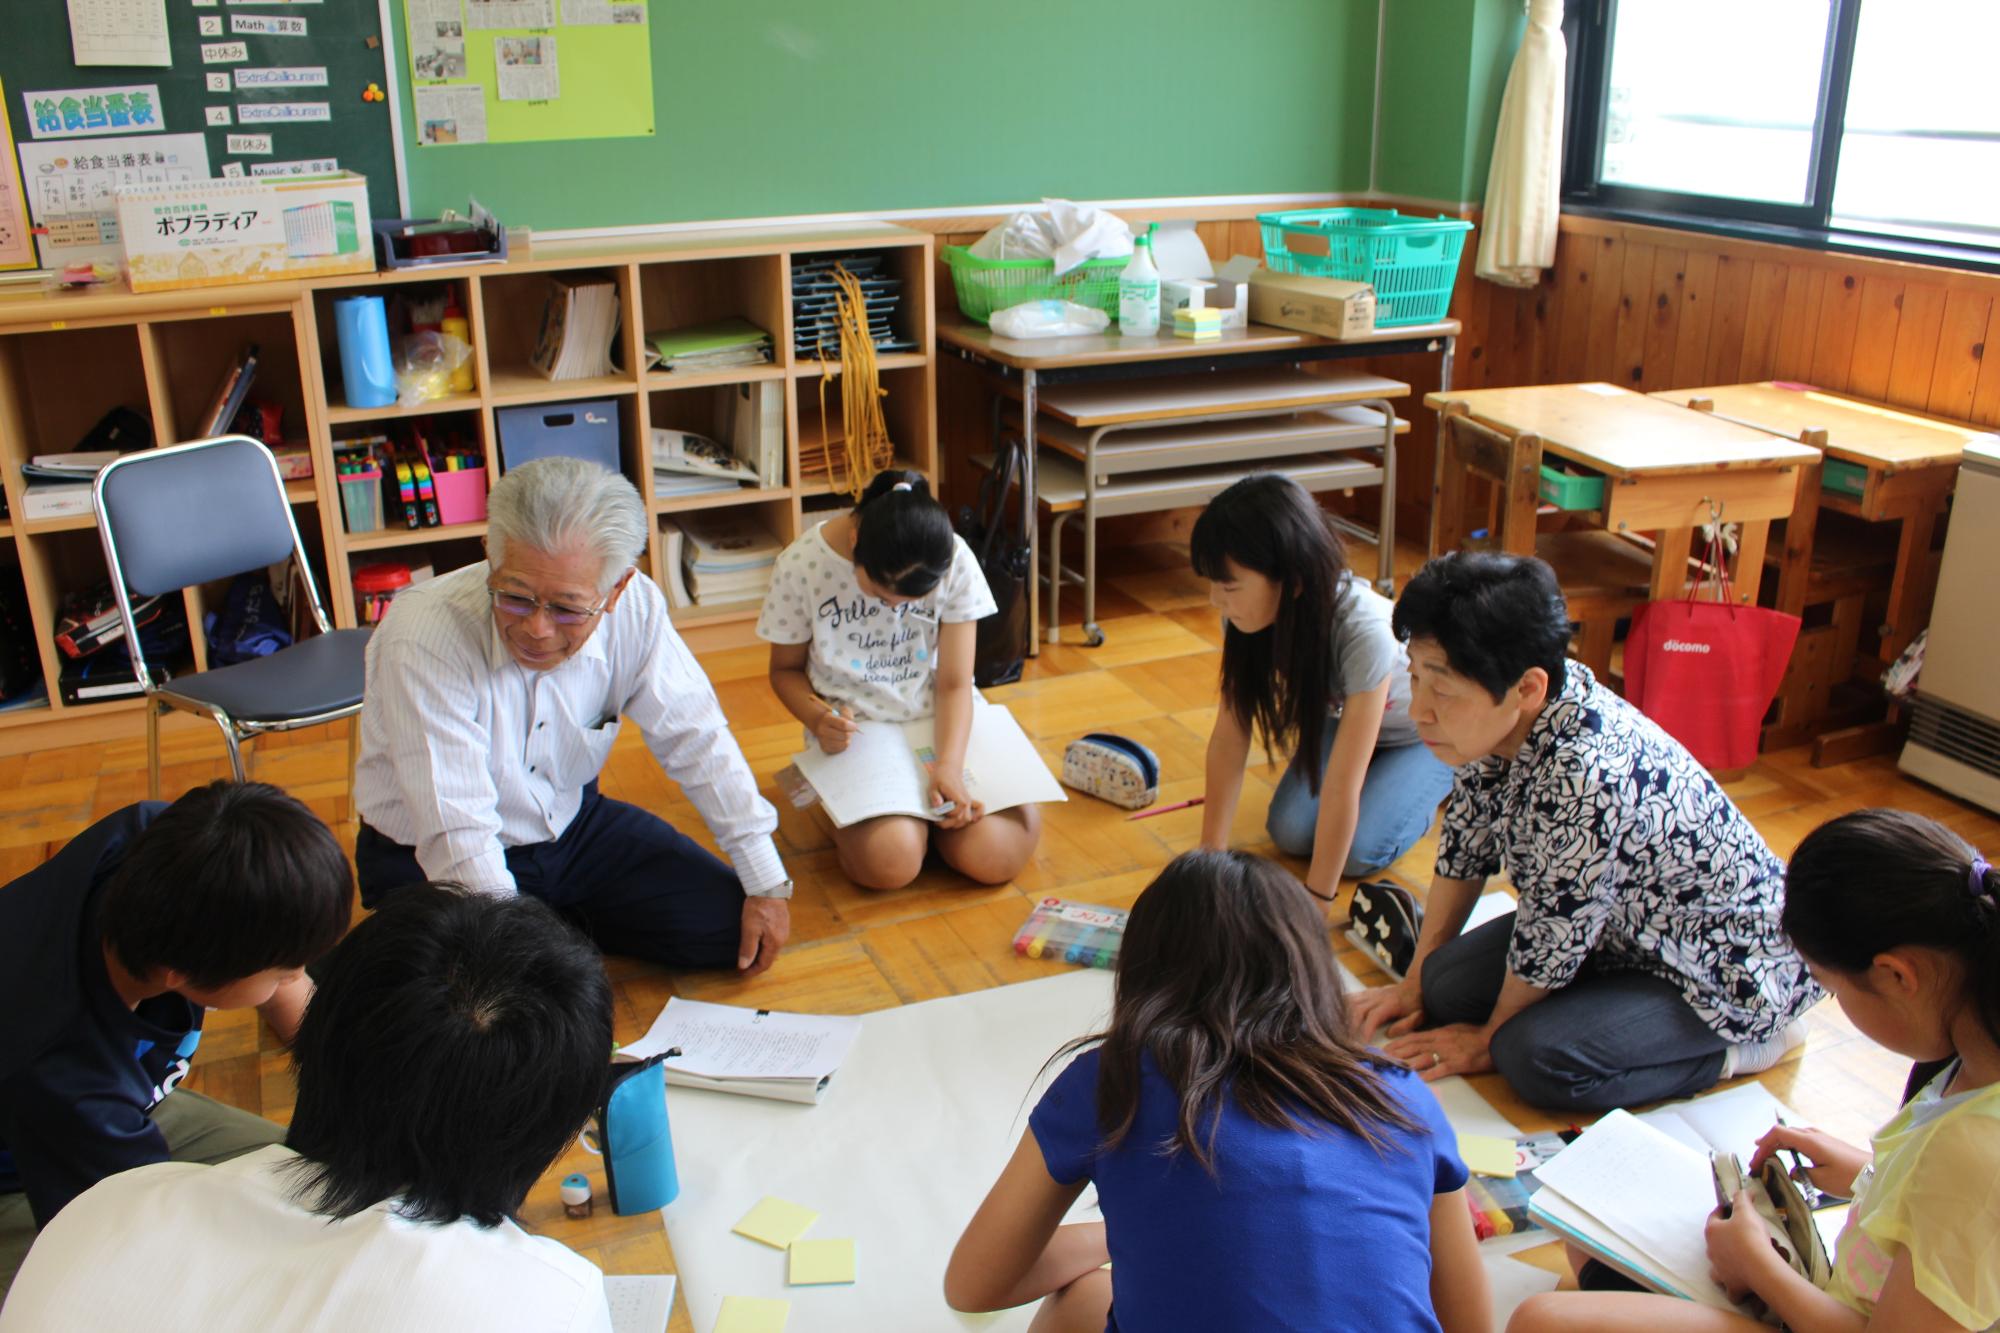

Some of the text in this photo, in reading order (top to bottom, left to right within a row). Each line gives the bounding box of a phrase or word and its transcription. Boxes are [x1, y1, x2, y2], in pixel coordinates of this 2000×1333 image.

[204, 20, 215, 32] 2
[235, 20, 302, 32] Math 算数
[204, 46, 243, 59] 中休み
[213, 76, 224, 89] 3
[33, 92, 155, 132] 給食当番表
[214, 110, 224, 121] 4
[73, 153, 152, 170] 給食当番表
[253, 168, 286, 177] Music
[156, 211, 258, 236] ポプラディア
[818, 596, 880, 628] Fille
[847, 627, 920, 652] Une fille
[865, 652, 914, 671] devient
